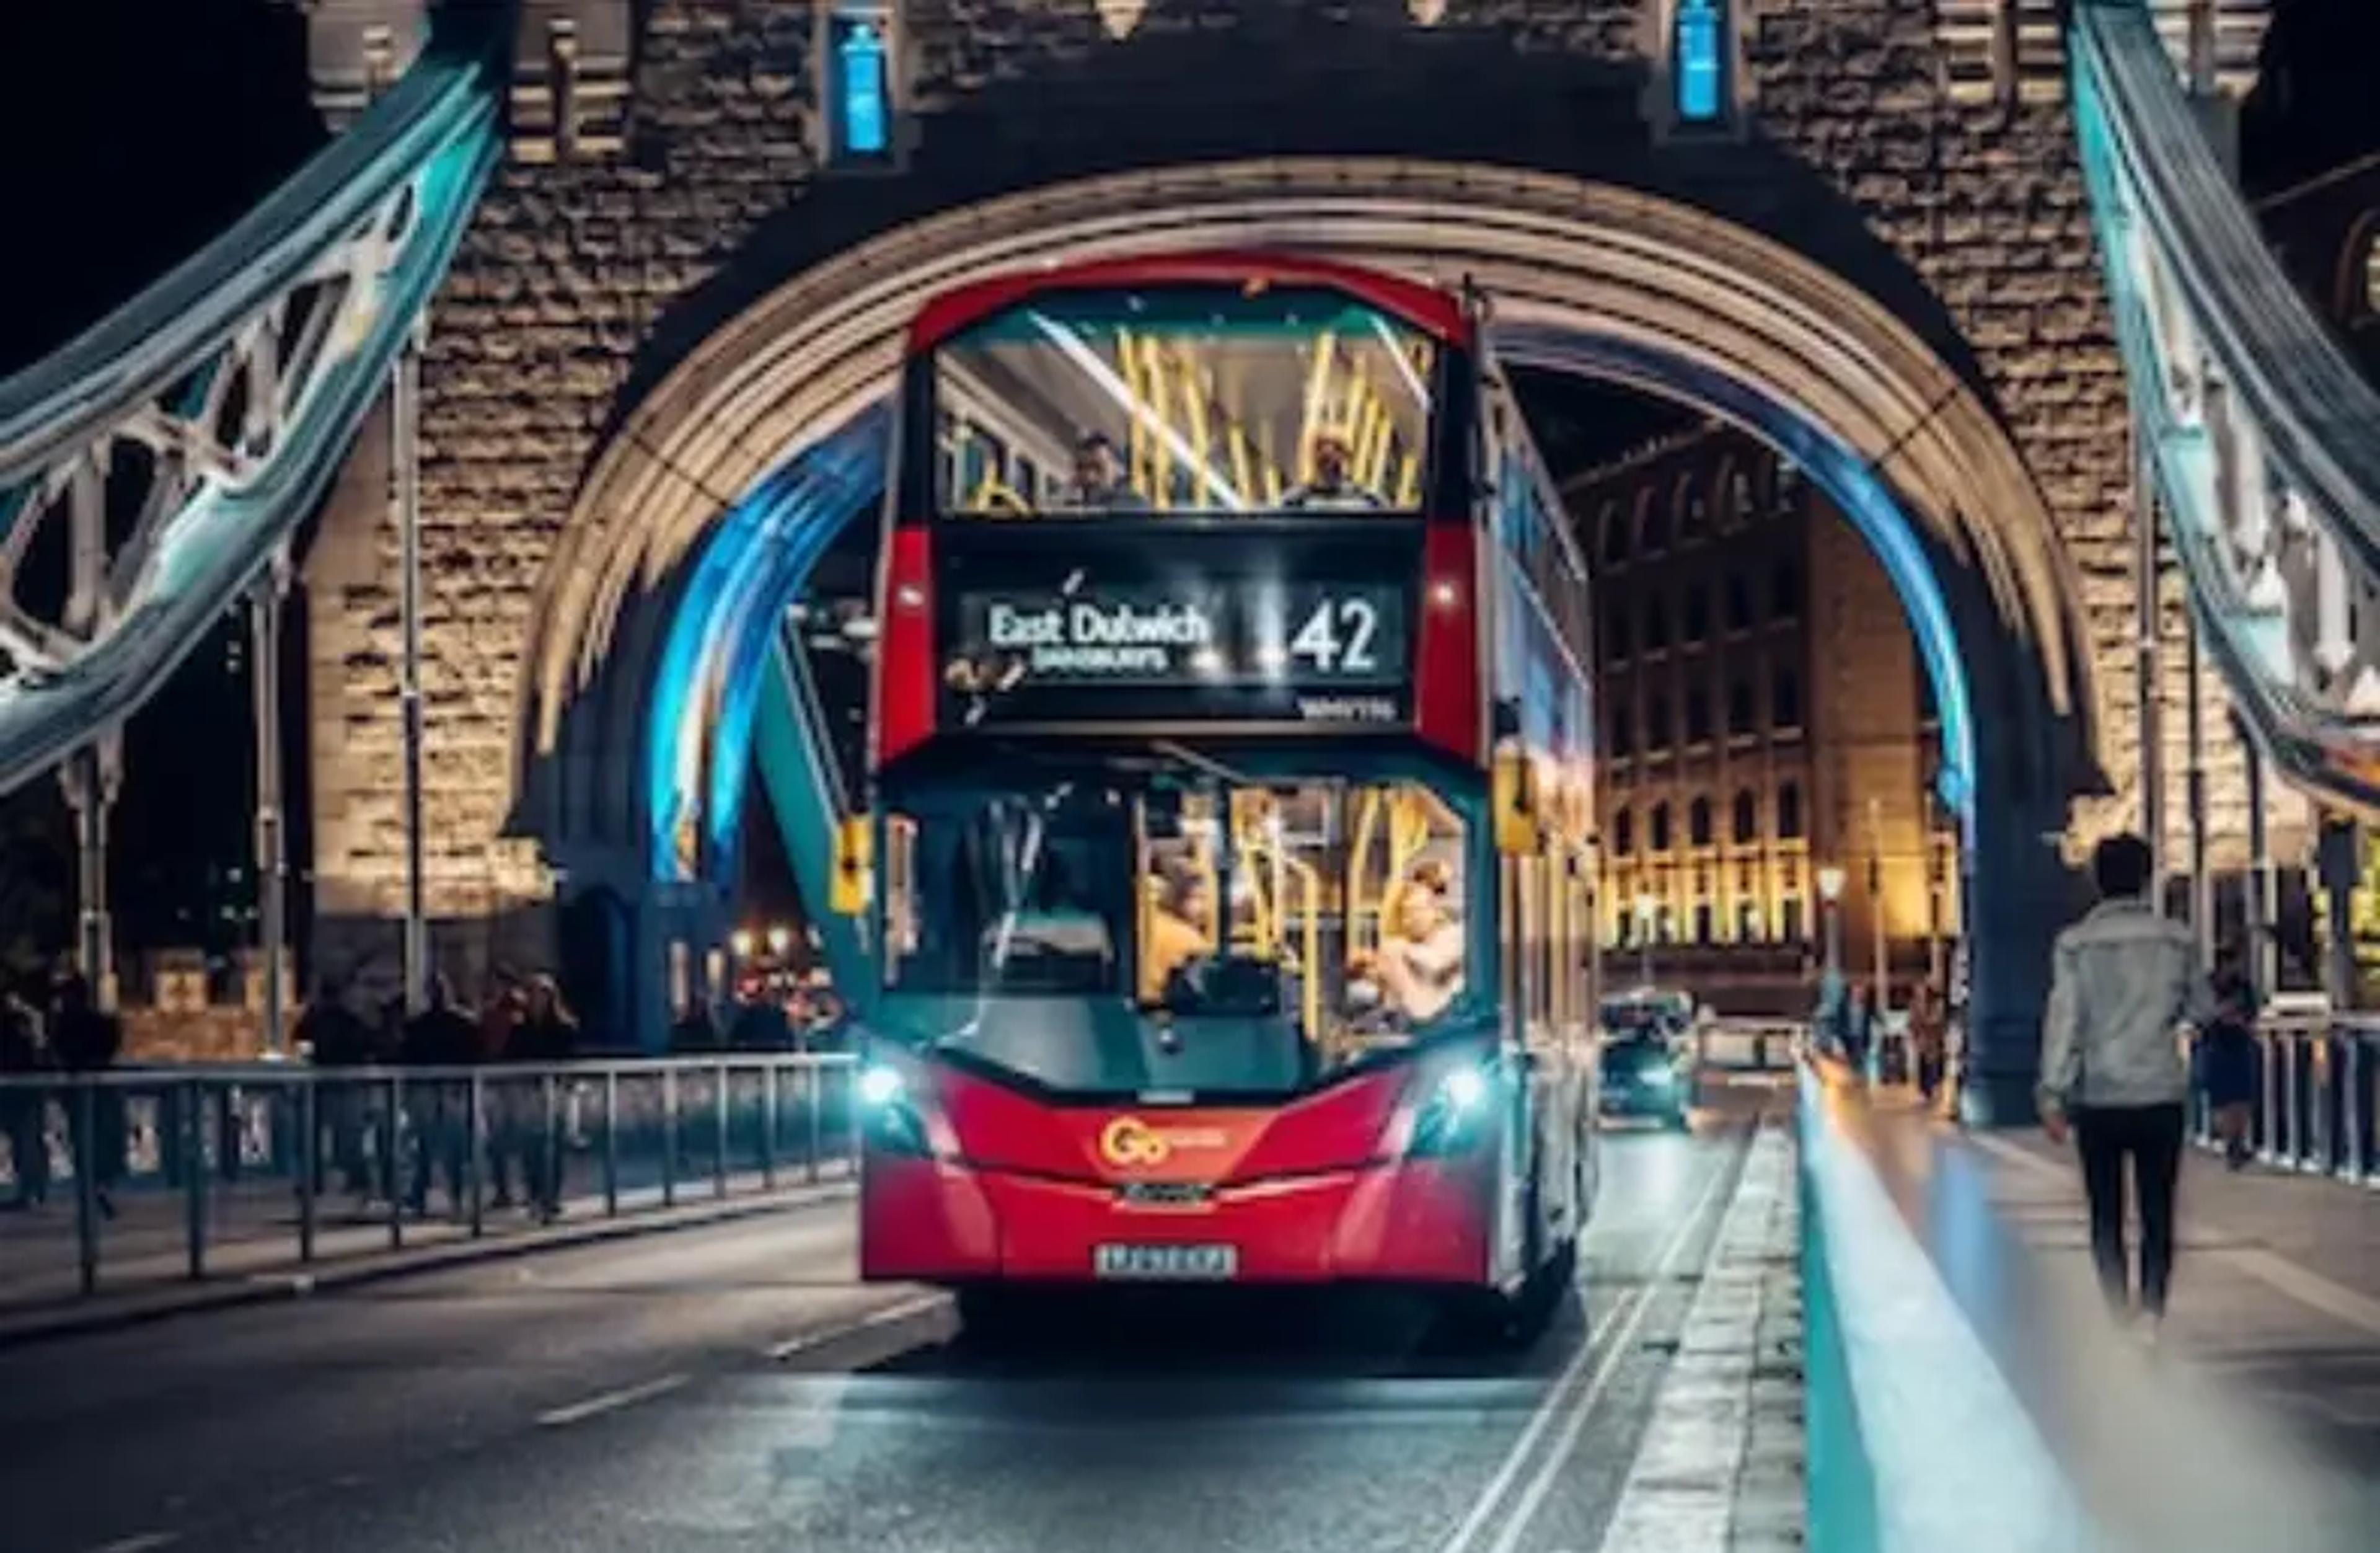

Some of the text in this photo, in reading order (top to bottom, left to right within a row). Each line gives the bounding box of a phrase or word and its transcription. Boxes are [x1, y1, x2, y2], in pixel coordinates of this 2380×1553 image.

[990, 603, 1210, 644] East Dulwich
[1292, 598, 1378, 672] 42
